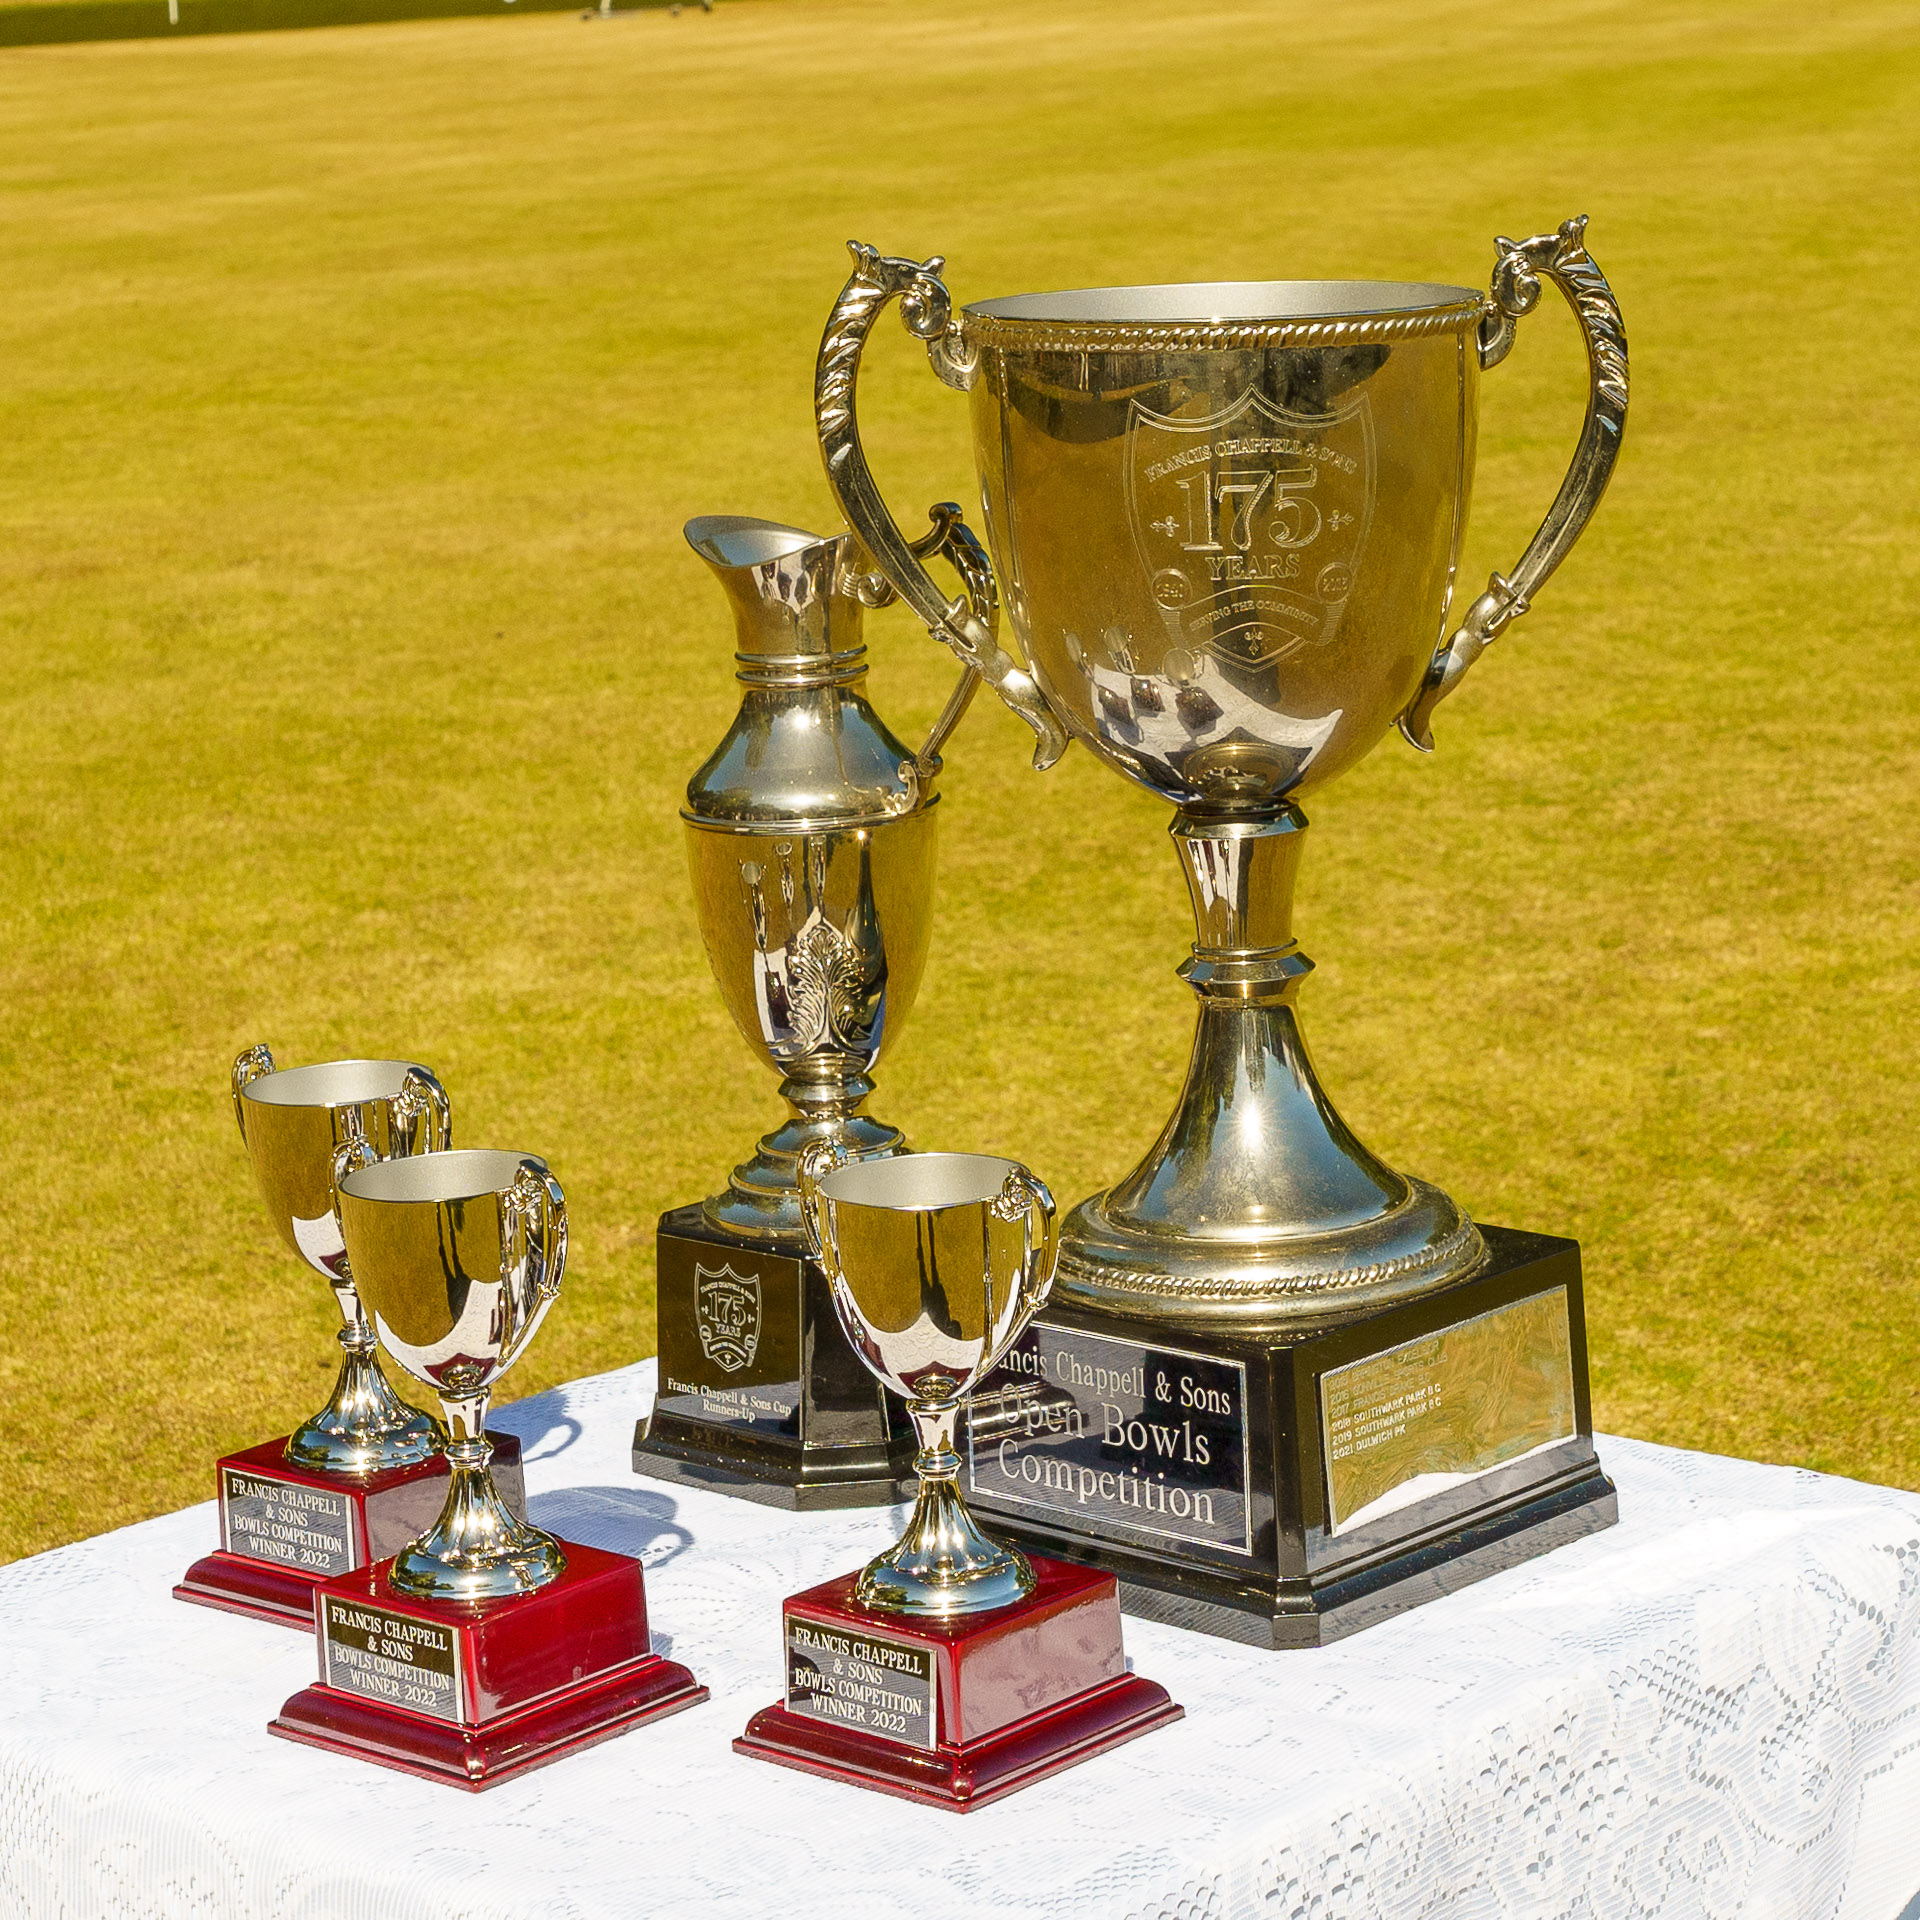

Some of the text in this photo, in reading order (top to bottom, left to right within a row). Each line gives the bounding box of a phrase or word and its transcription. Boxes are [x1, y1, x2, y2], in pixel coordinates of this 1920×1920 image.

[1144, 444, 1212, 483] FRANCIS
[1215, 438, 1302, 457] CHAPPELL
[1304, 443, 1317, 457] &
[1176, 464, 1322, 551] 175
[1205, 554, 1300, 581] YEARS
[1231, 599, 1255, 614] THE
[708, 1291, 746, 1327] 175
[715, 1323, 741, 1338] YEARS
[667, 1378, 792, 1417] Francis Chappell & Sons Cup
[998, 1346, 1231, 1415] ancis Chappell & Sons
[703, 1399, 756, 1423] Runners-Up
[1000, 1383, 1210, 1465] Open Bowls
[1332, 1416, 1351, 1432] 2018
[1354, 1396, 1405, 1424] SOUTHWARK
[1405, 1388, 1427, 1405] PARK
[1332, 1430, 1352, 1446] 2019
[1355, 1410, 1406, 1437] SOUTHWARK
[1406, 1402, 1427, 1419] PARK
[1333, 1424, 1406, 1460] 2021 DULWICH PK
[232, 1478, 340, 1516] FRANCIS CHAPPELL
[999, 1438, 1215, 1525] Competition
[234, 1514, 342, 1553] BOWLS COMPETITION
[266, 1504, 308, 1527] & SONS
[249, 1536, 330, 1568] WINNER 2022
[331, 1606, 448, 1651] FRANCIS CHAPPELL
[334, 1645, 450, 1691] BOWLS COMPETITION
[368, 1636, 414, 1662] & SONS
[795, 1626, 923, 1675] FRANCIS CHAPPELL
[350, 1669, 437, 1707] WINNER 2022
[833, 1658, 883, 1685] & SONS
[795, 1667, 922, 1717] BOWLS COMPETITION
[810, 1692, 907, 1733] WINNER 2022
